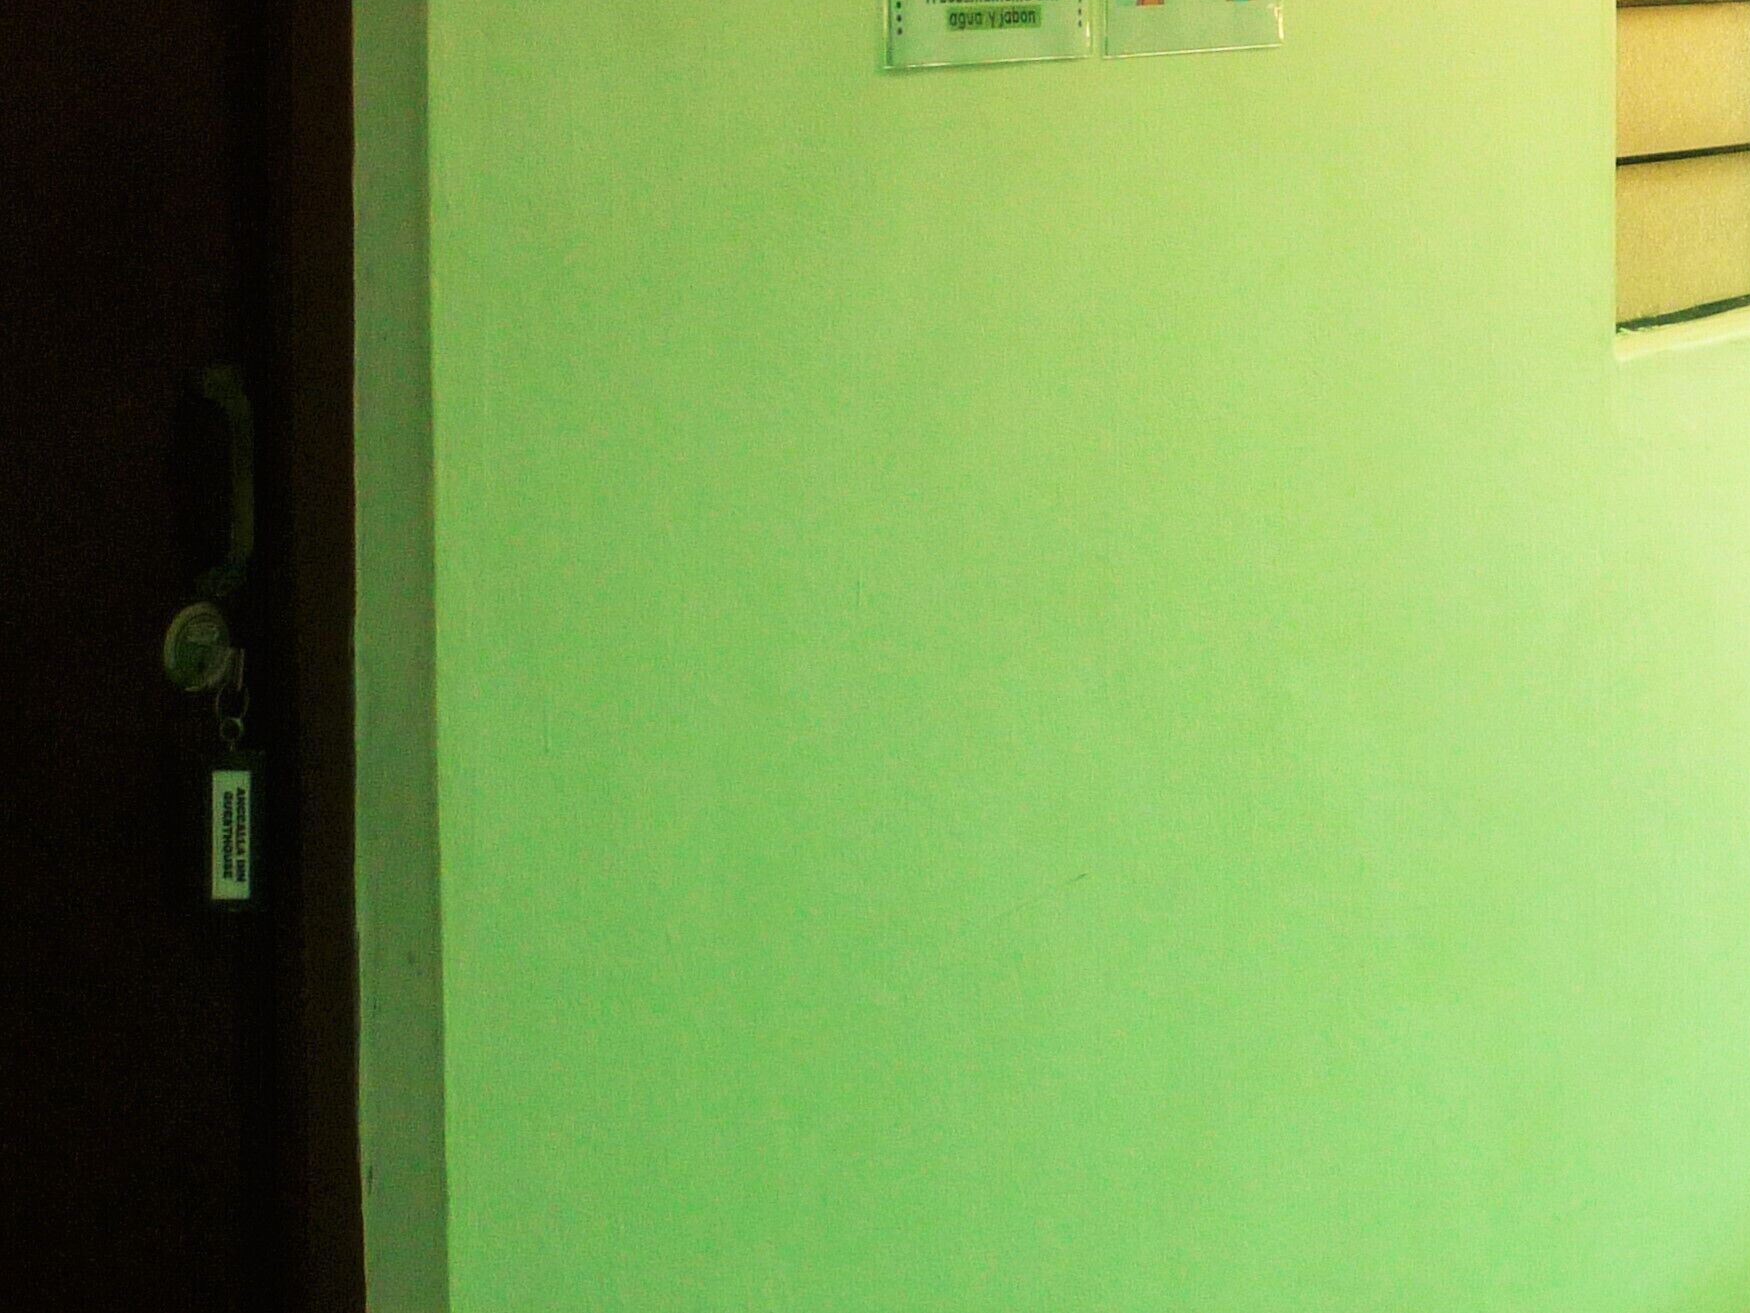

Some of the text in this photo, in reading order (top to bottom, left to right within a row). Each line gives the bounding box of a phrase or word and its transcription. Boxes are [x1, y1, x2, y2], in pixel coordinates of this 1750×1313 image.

[949, 11, 982, 29] agua
[988, 13, 997, 28] y
[222, 791, 233, 879] GUESTHOUSE
